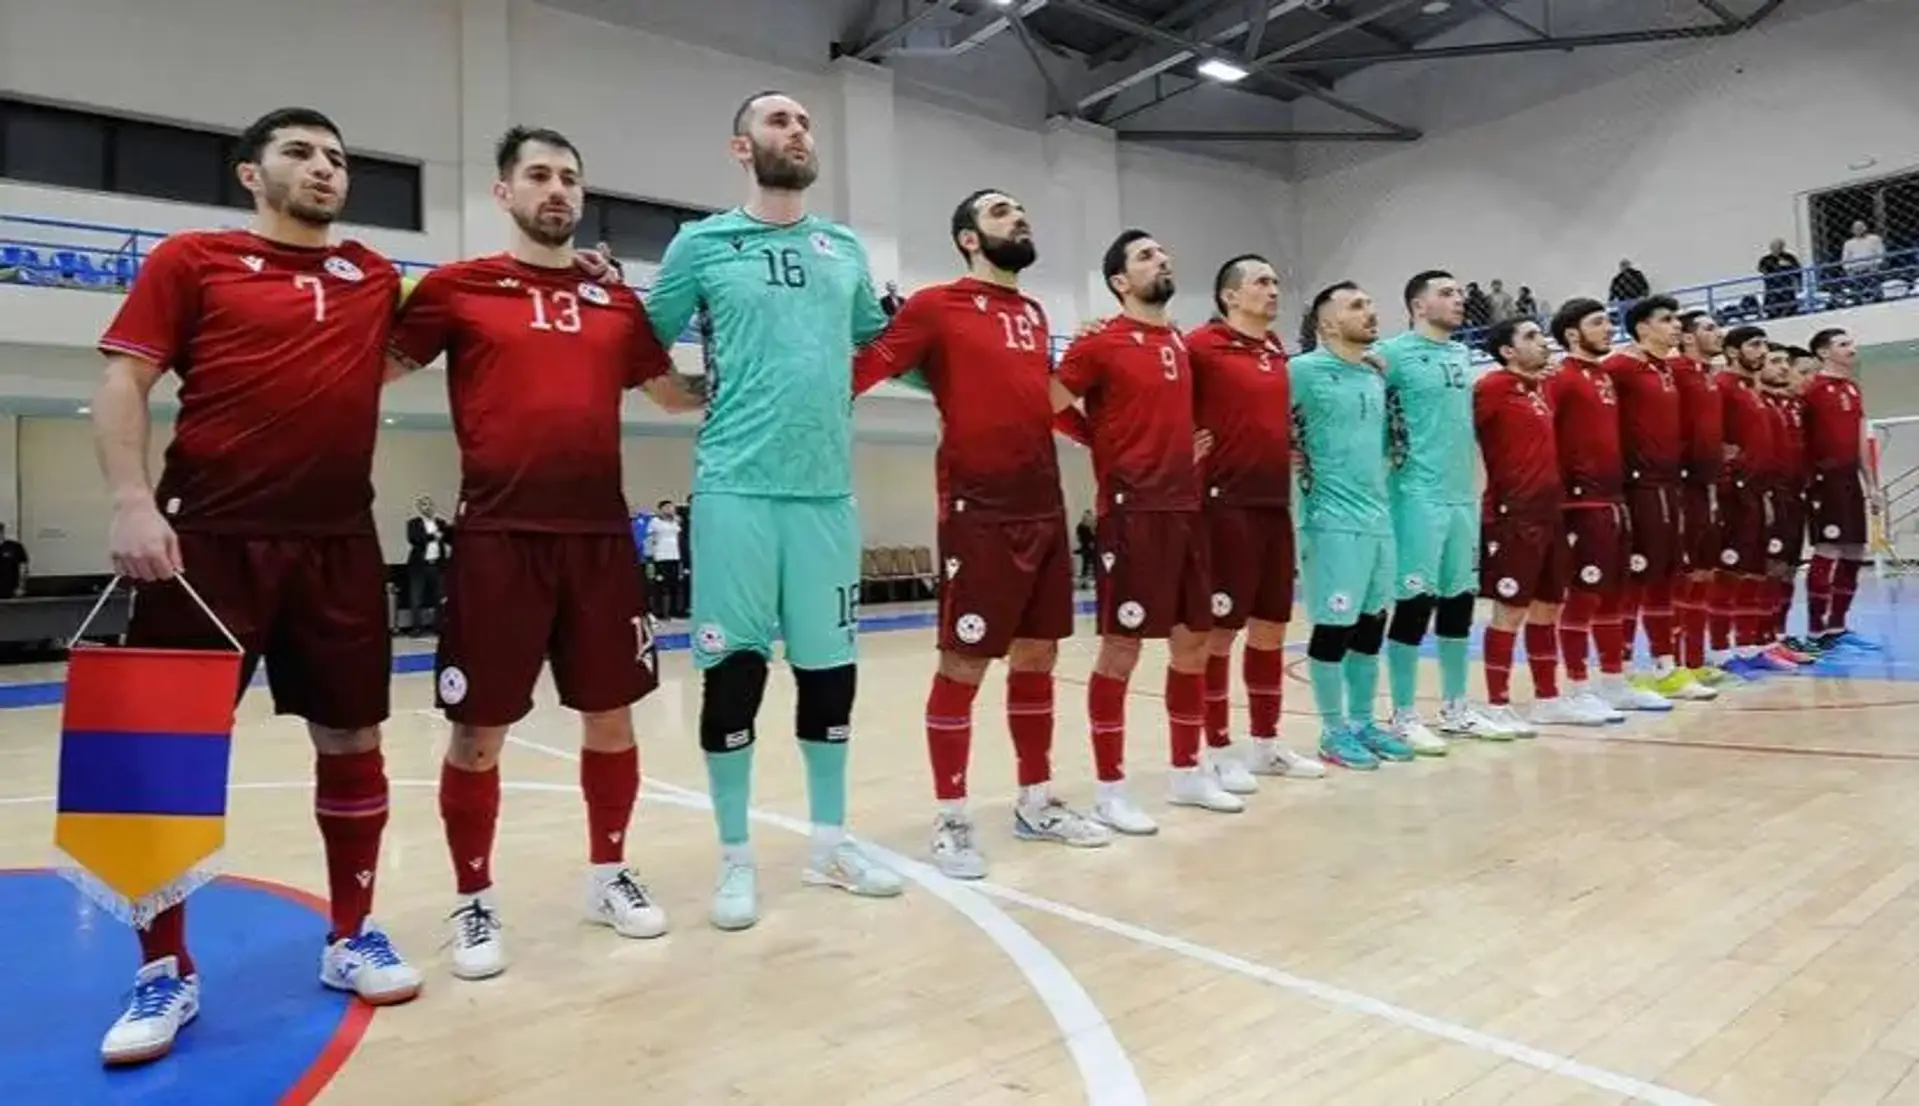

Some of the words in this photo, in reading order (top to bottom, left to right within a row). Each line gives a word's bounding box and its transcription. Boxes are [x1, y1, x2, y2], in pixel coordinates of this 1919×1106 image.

[760, 247, 806, 288] 16
[294, 275, 324, 322] 7
[527, 286, 580, 333] 13
[996, 311, 1036, 351] 19
[1160, 345, 1179, 381] 9
